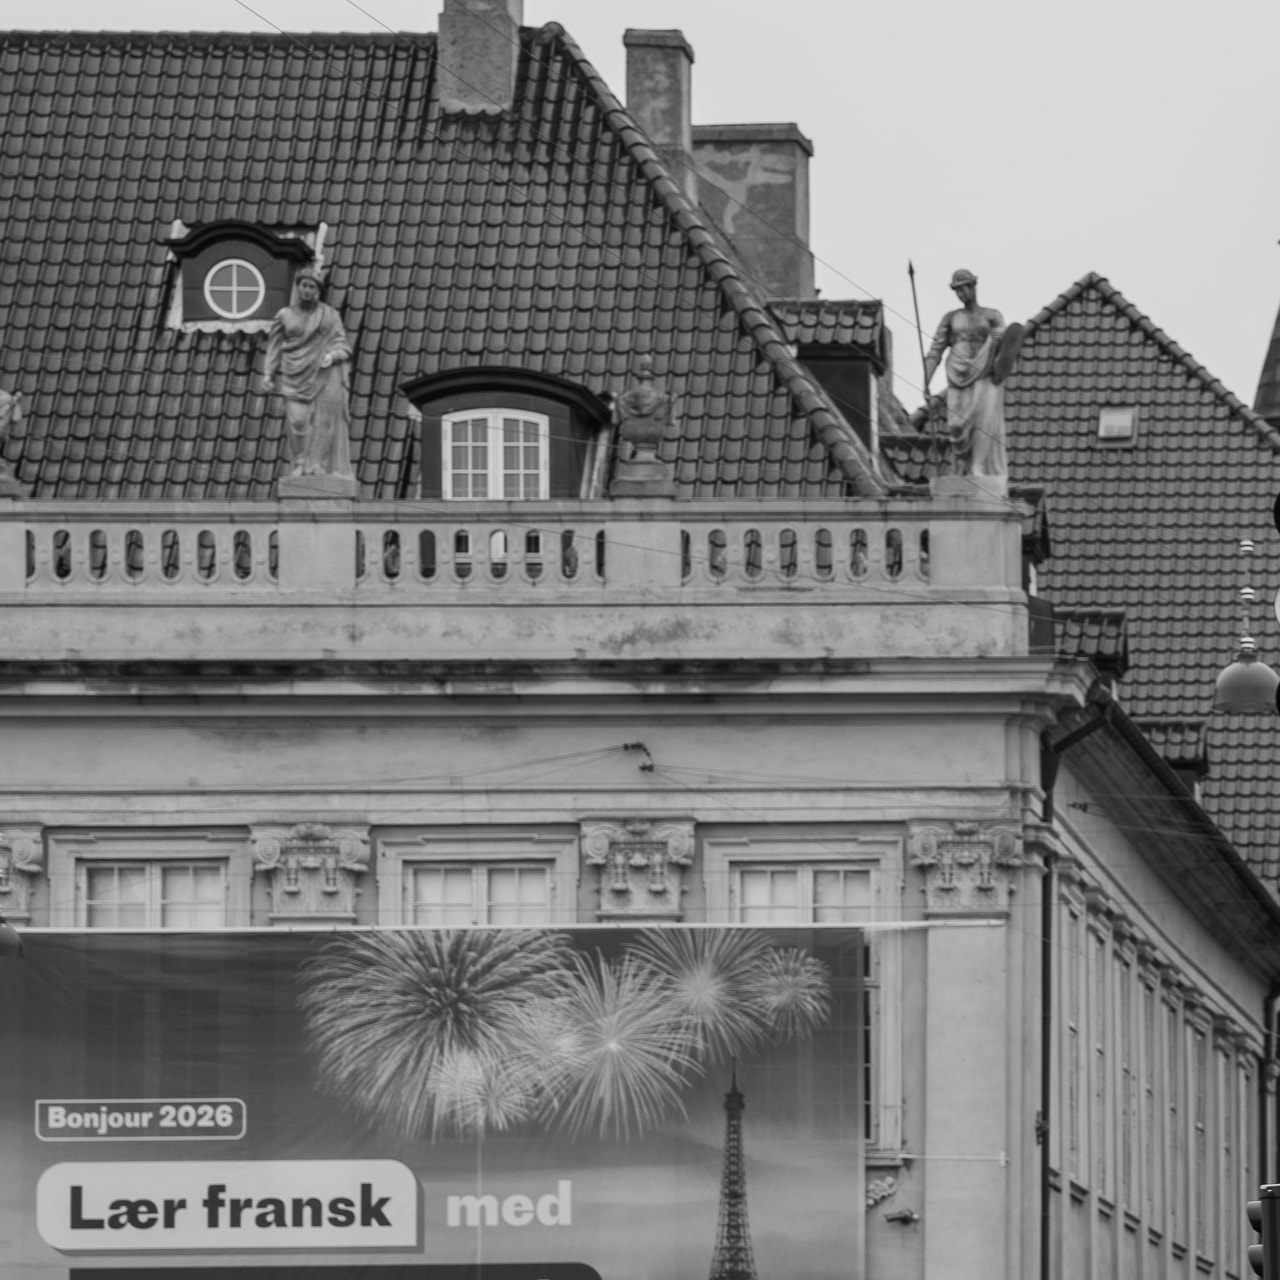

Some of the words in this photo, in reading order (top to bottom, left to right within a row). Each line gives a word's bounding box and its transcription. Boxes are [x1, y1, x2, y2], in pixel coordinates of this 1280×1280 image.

[48, 1105, 153, 1135] Bonjour
[159, 1104, 234, 1128] 2026
[70, 1185, 187, 1230] Lær
[202, 1183, 393, 1228] fransk
[447, 1180, 572, 1227] med
